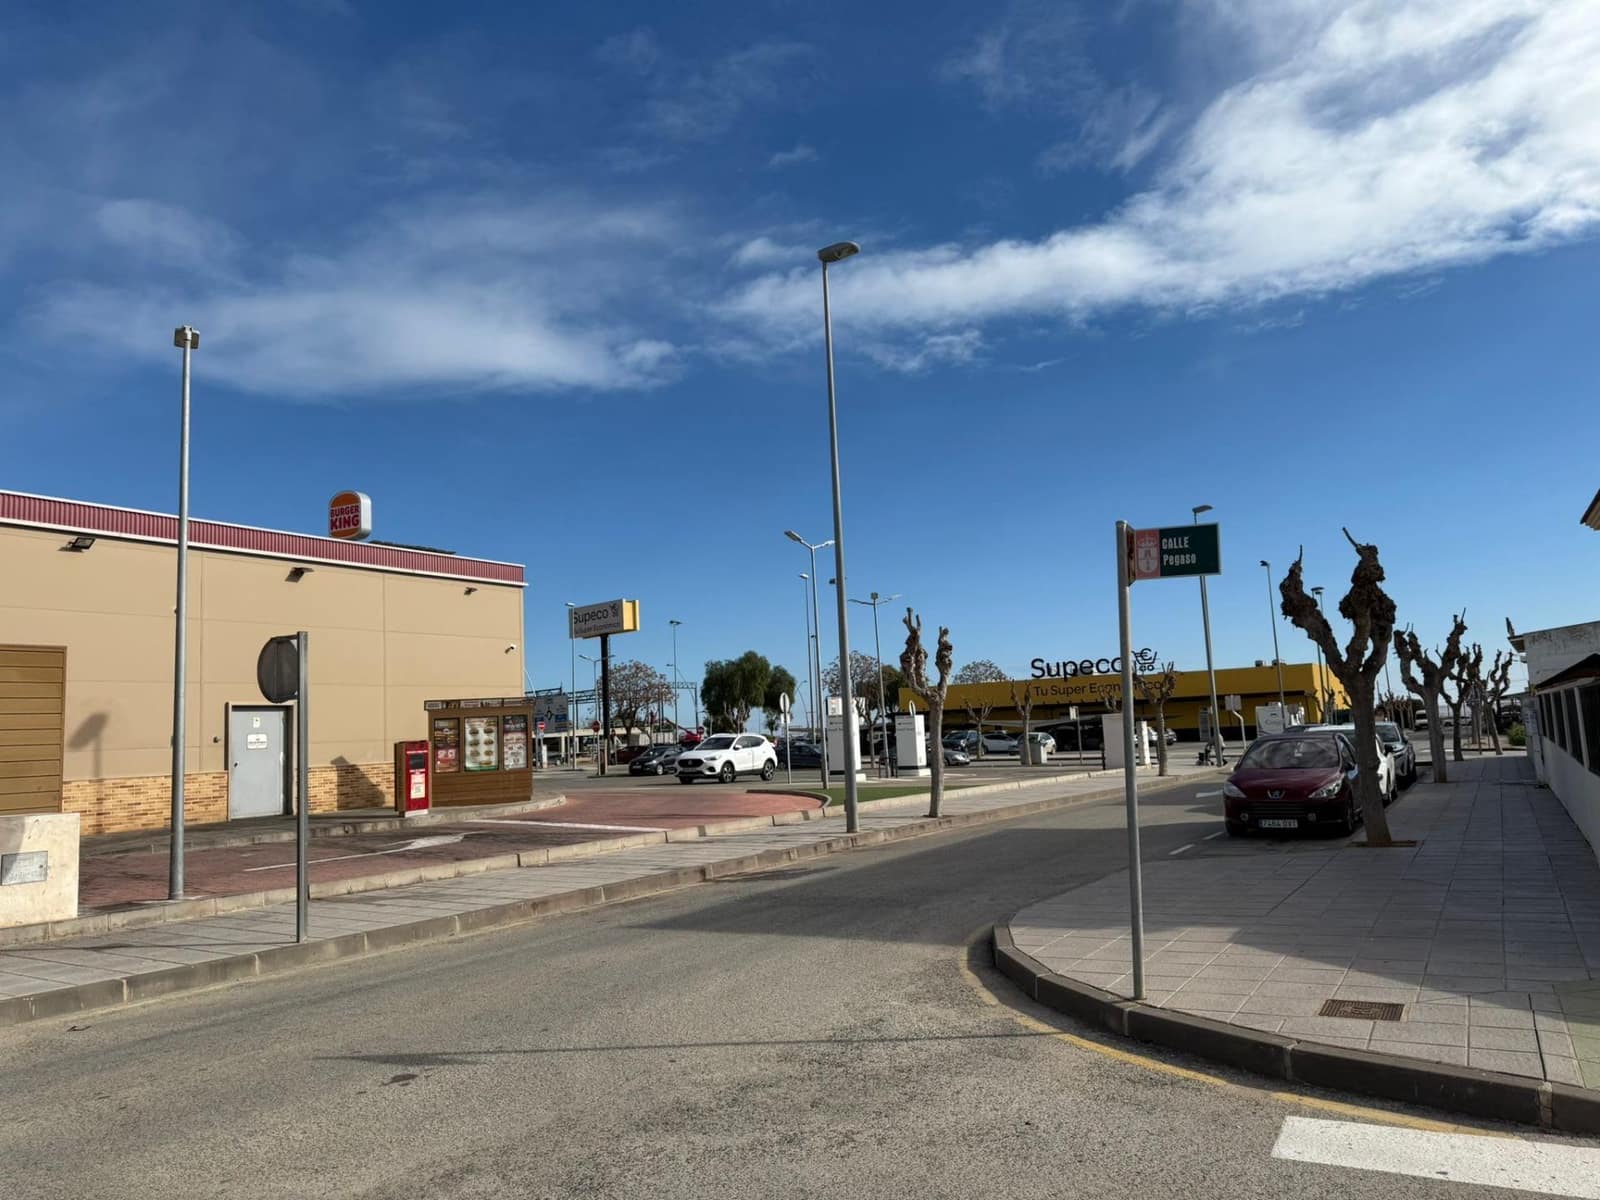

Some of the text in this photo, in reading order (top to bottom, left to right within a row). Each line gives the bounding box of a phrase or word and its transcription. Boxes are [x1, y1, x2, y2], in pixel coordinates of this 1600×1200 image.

[330, 504, 359, 517] BURGER
[330, 514, 359, 530] KING
[1161, 536, 1189, 550] CALLE
[1162, 554, 1197, 566] Pegaso
[573, 608, 609, 624] Supeco
[1034, 686, 1048, 697] Tu
[1050, 684, 1086, 697] Super
